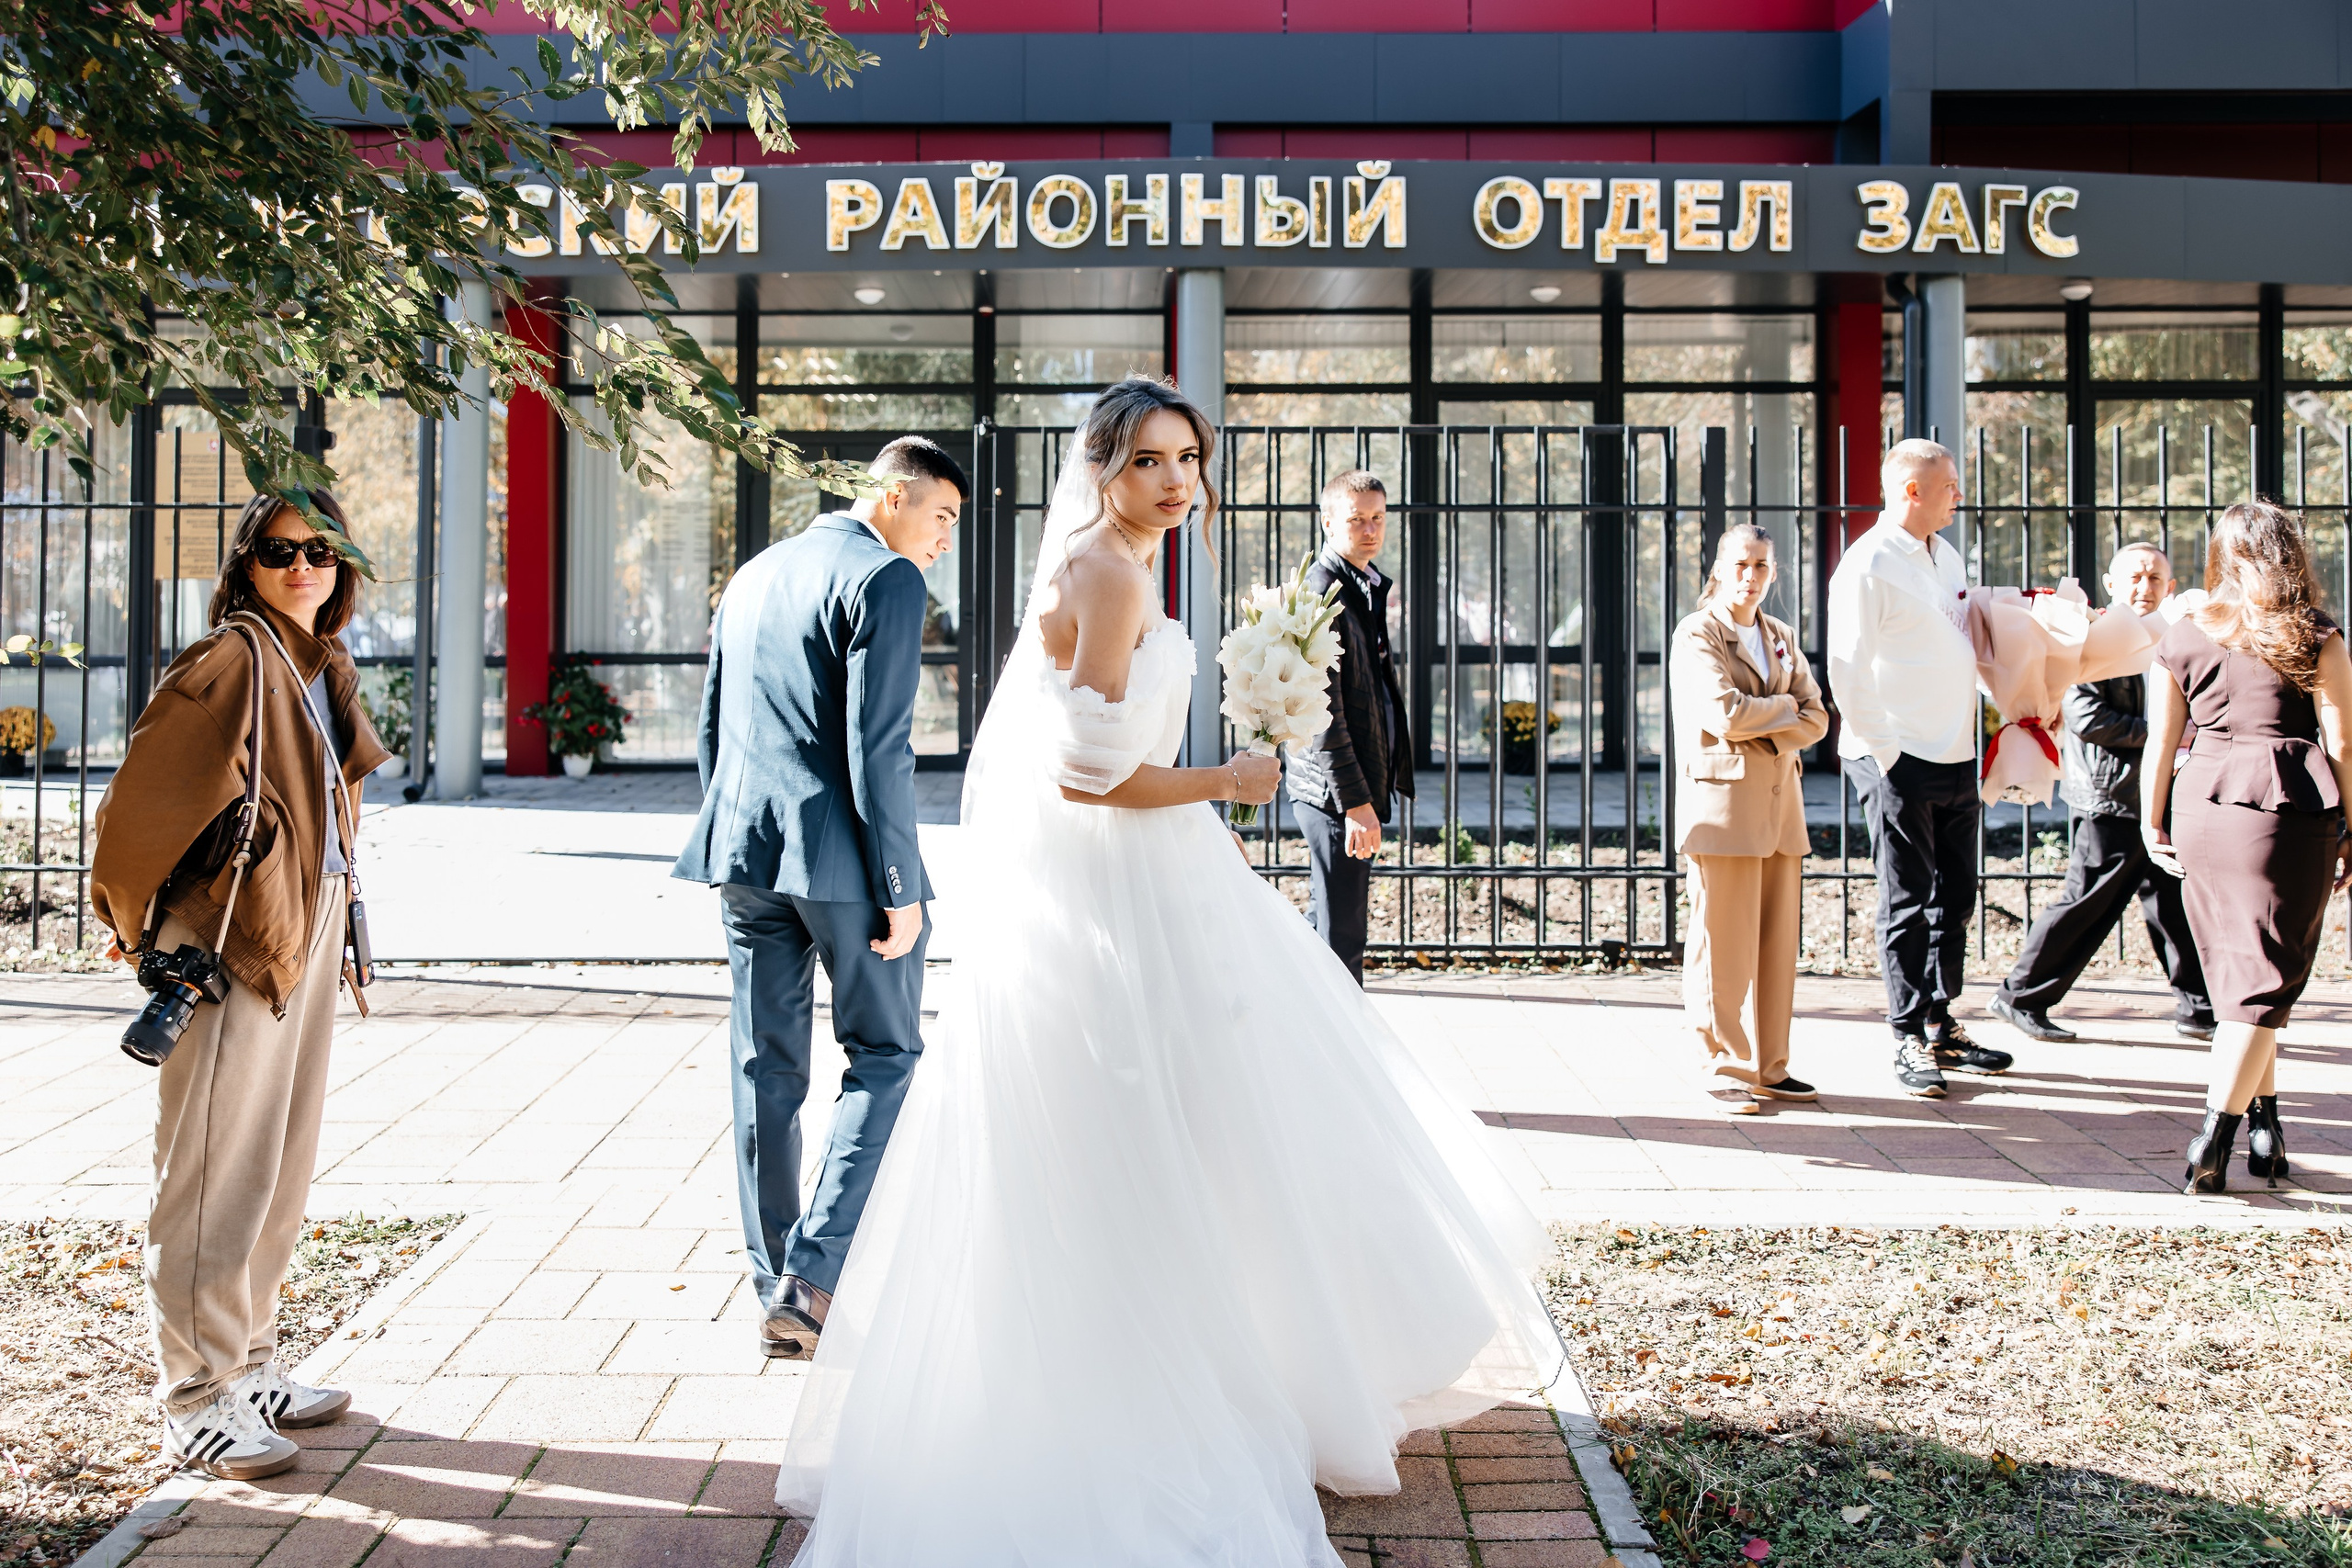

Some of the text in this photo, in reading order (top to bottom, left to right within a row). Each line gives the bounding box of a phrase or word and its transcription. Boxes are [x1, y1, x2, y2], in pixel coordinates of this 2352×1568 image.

[825, 160, 1407, 252] РАЙОННЫЙ
[1473, 175, 1793, 264] ОТДЕЛ
[1856, 180, 2081, 257] ЗАГС
